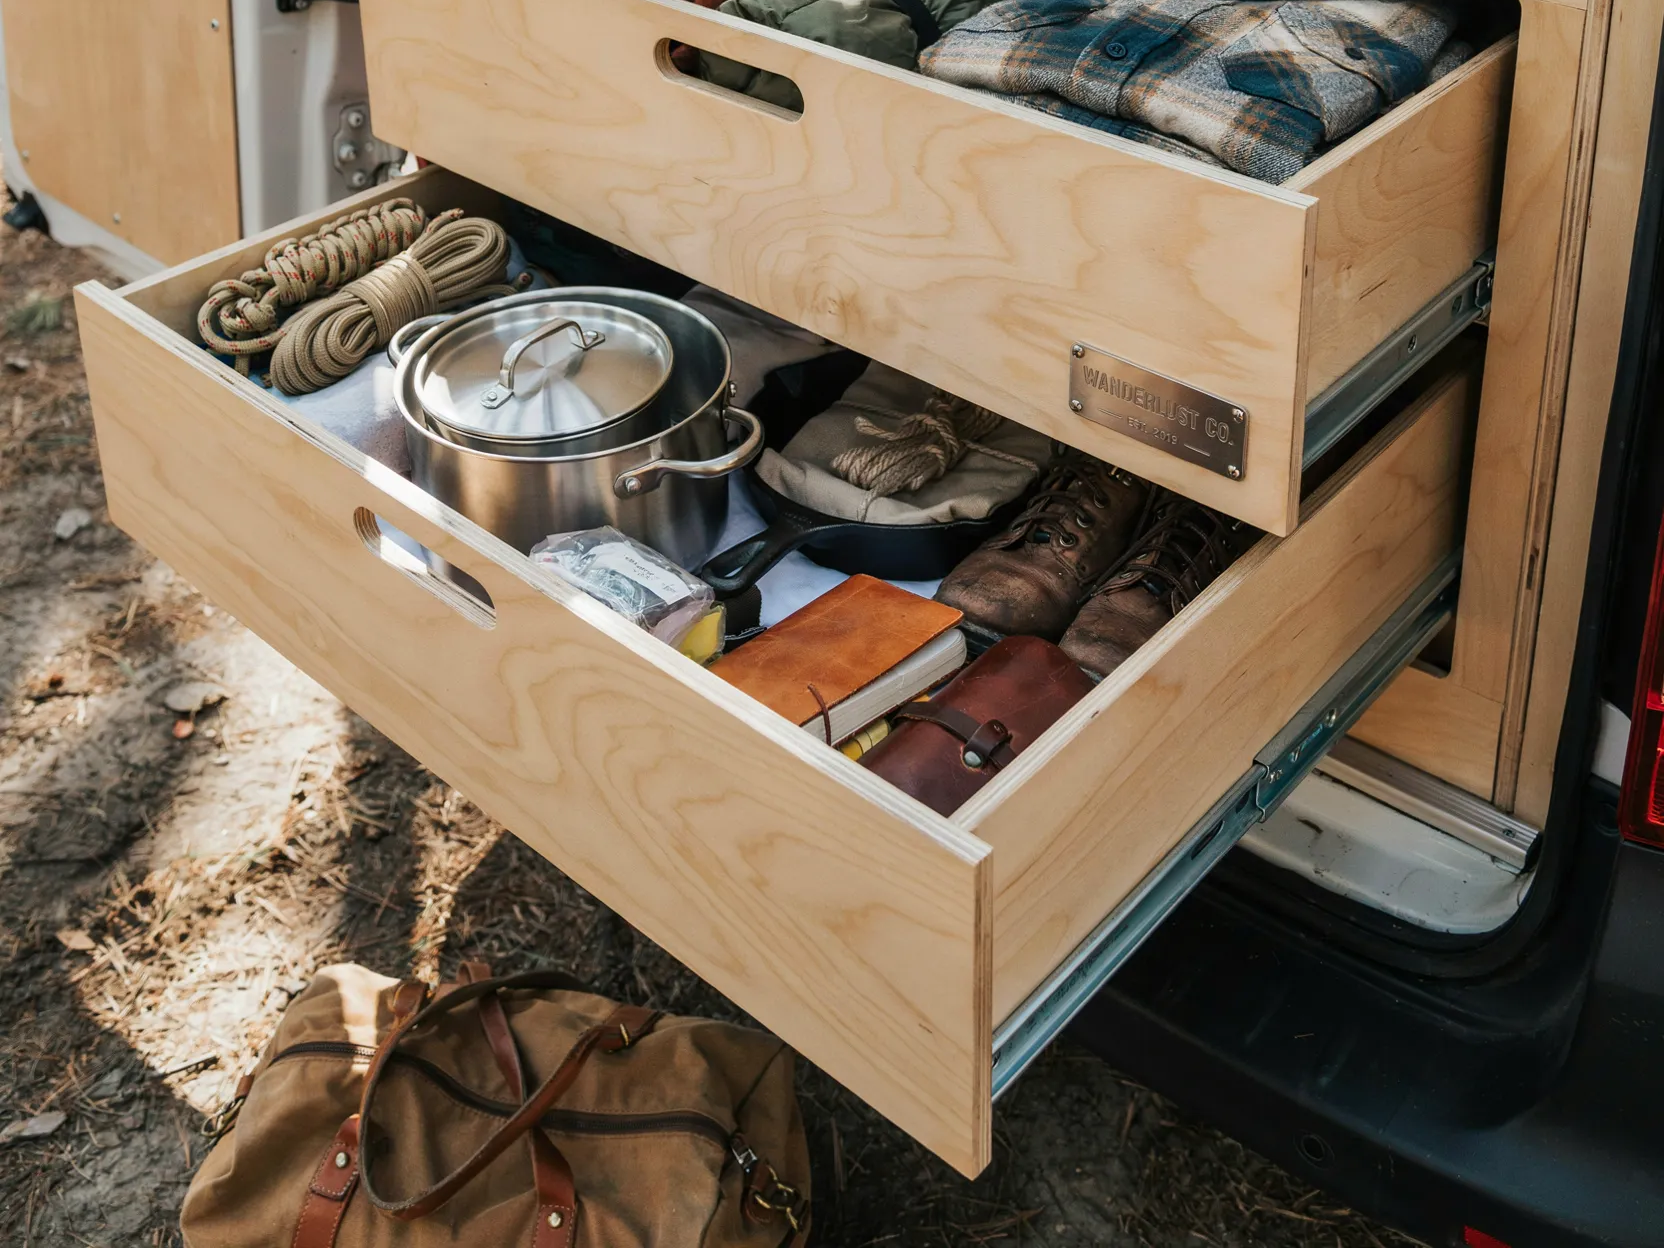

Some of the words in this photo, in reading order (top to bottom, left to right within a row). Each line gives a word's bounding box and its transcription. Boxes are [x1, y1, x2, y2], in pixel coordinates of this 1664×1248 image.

[1083, 365, 1200, 431] WANDERLUST
[1205, 417, 1234, 446] CO.
[1128, 416, 1148, 434] EST.
[1153, 427, 1178, 445] 2019
